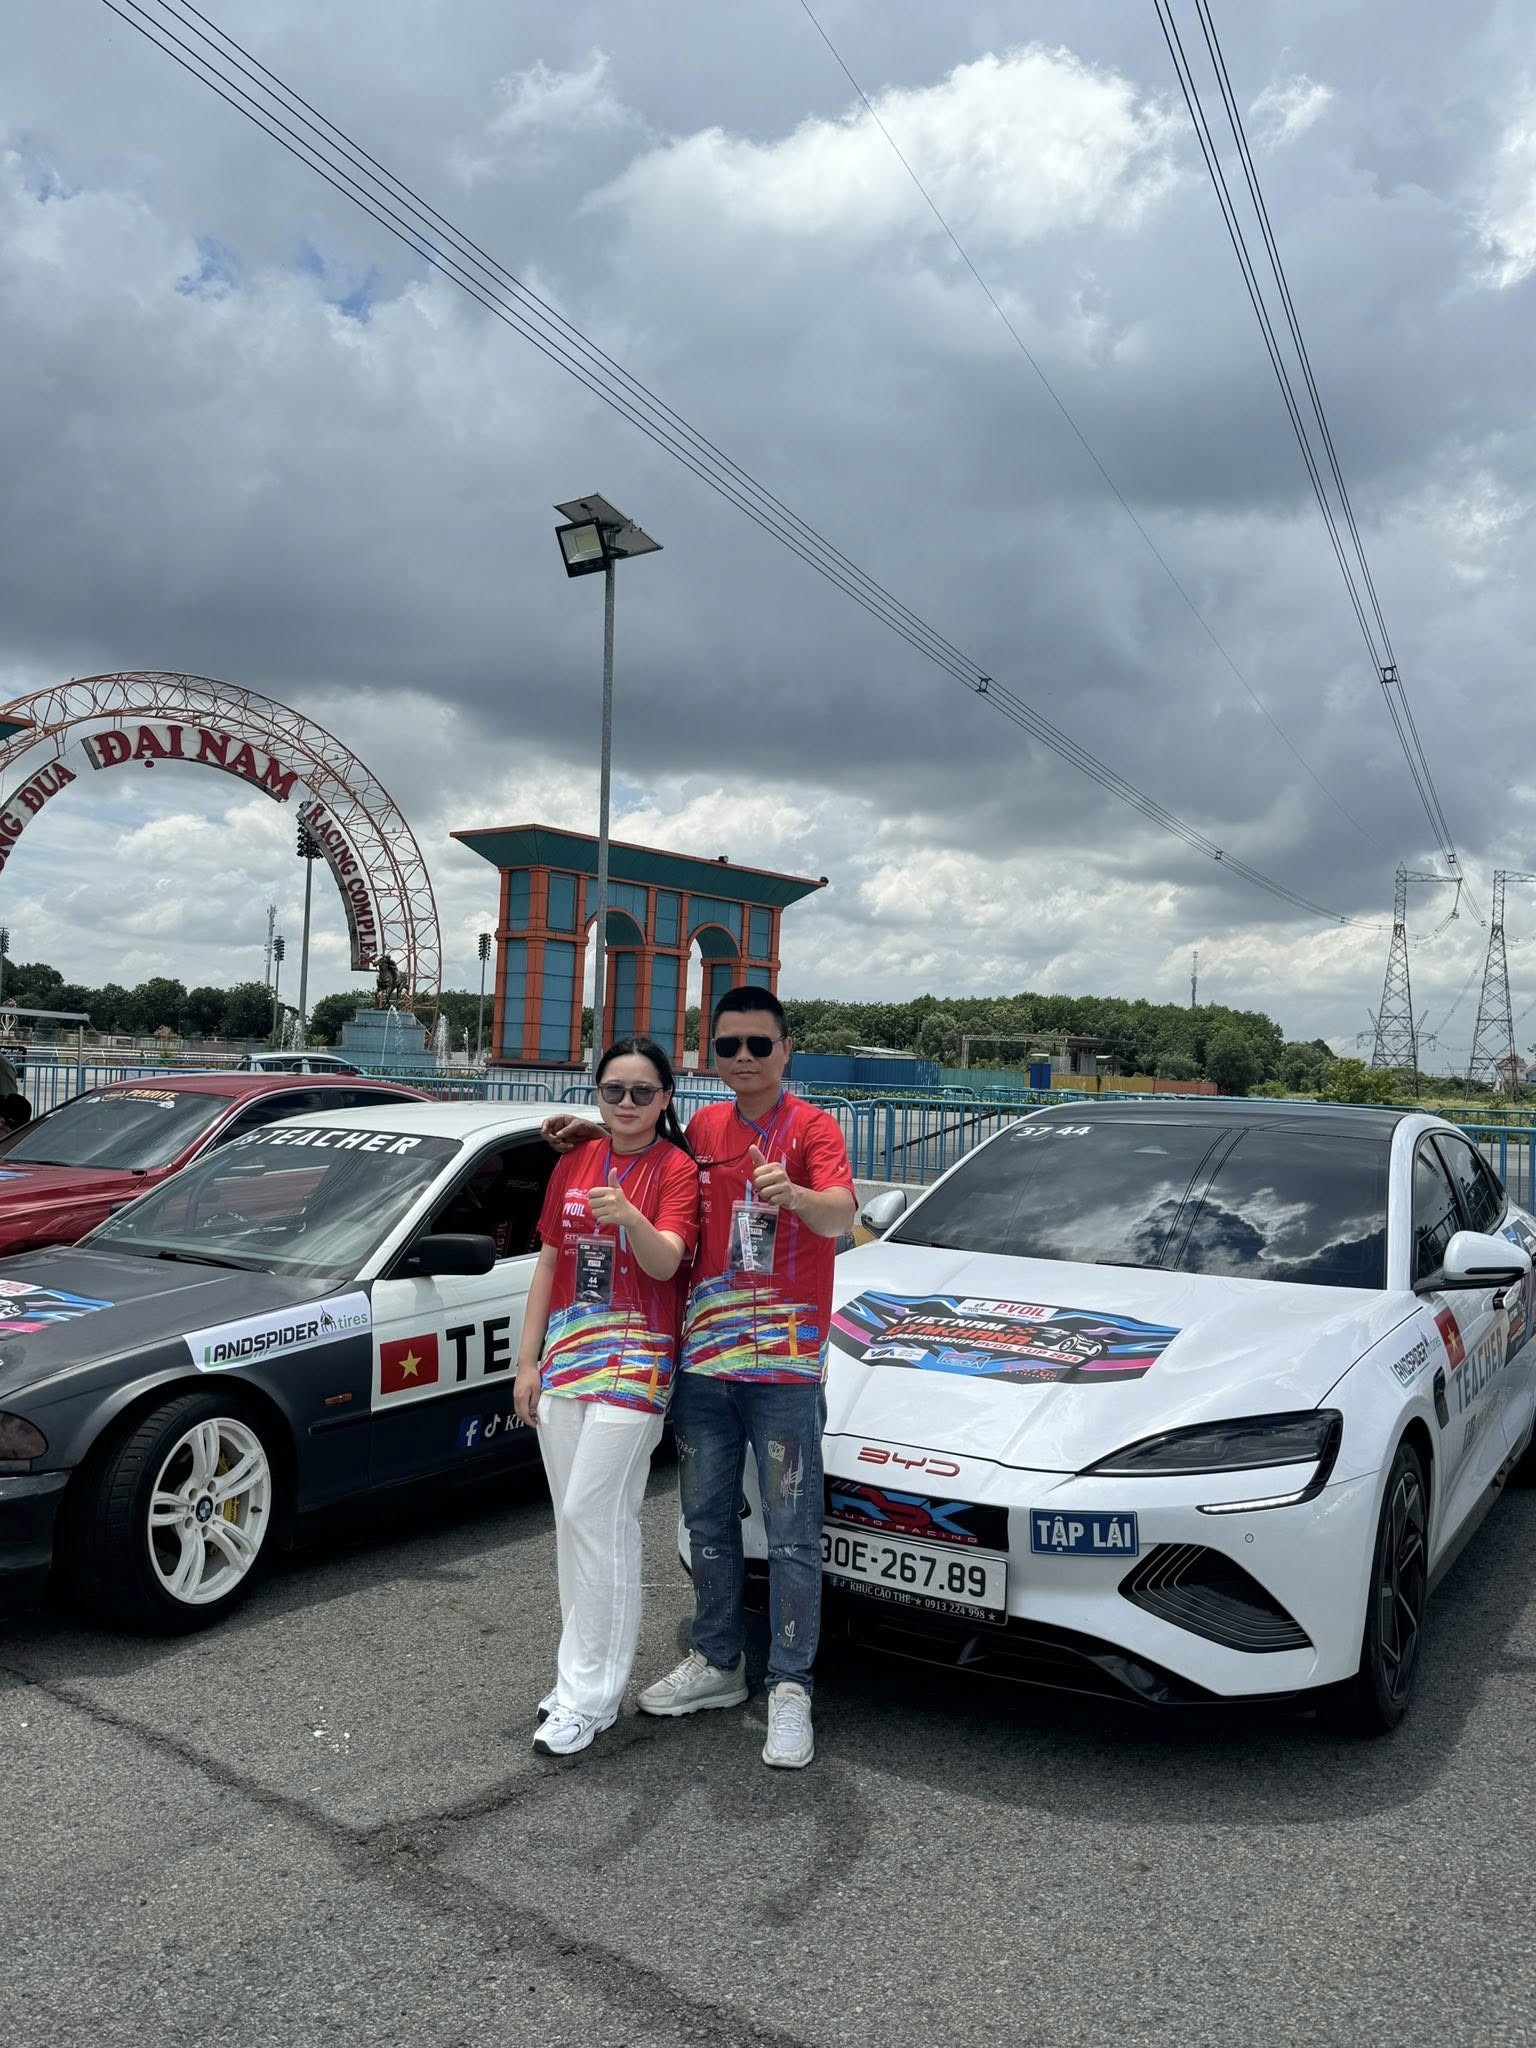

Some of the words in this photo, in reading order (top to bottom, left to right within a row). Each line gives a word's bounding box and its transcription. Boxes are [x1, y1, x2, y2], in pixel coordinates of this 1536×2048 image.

[94, 725, 187, 768] ĐẠI
[197, 729, 298, 800] NAM
[17, 762, 77, 815] ĐUA
[306, 803, 359, 876] RACING
[347, 878, 378, 970] COMPLEX
[256, 1129, 422, 1155] TEACHER
[1016, 1126, 1053, 1137] 37
[1056, 1126, 1091, 1136] 44
[588, 1276, 598, 1285] 44
[901, 1315, 1008, 1331] VIETNAM
[993, 1303, 1046, 1317] PVOIL
[204, 1321, 319, 1368] LANDSPIDER
[338, 1313, 368, 1330] tires
[445, 1316, 520, 1382] TE
[876, 1333, 975, 1346] CHAMPIONSHIP
[975, 1341, 1013, 1351] PVOIL
[1016, 1345, 1048, 1355] CUP
[1049, 1350, 1081, 1363] 2025
[885, 1323, 1032, 1346] GYMKHANA
[857, 1446, 961, 1478] BYD
[832, 1510, 882, 1527] AUTO
[895, 1525, 979, 1544] RACING
[1037, 1516, 1084, 1551] TẬP
[1093, 1517, 1131, 1548] LÁI
[820, 1533, 986, 1598] 30E-267.89
[925, 1599, 947, 1611] 0913
[949, 1603, 965, 1615] 224
[969, 1608, 985, 1619] 998
